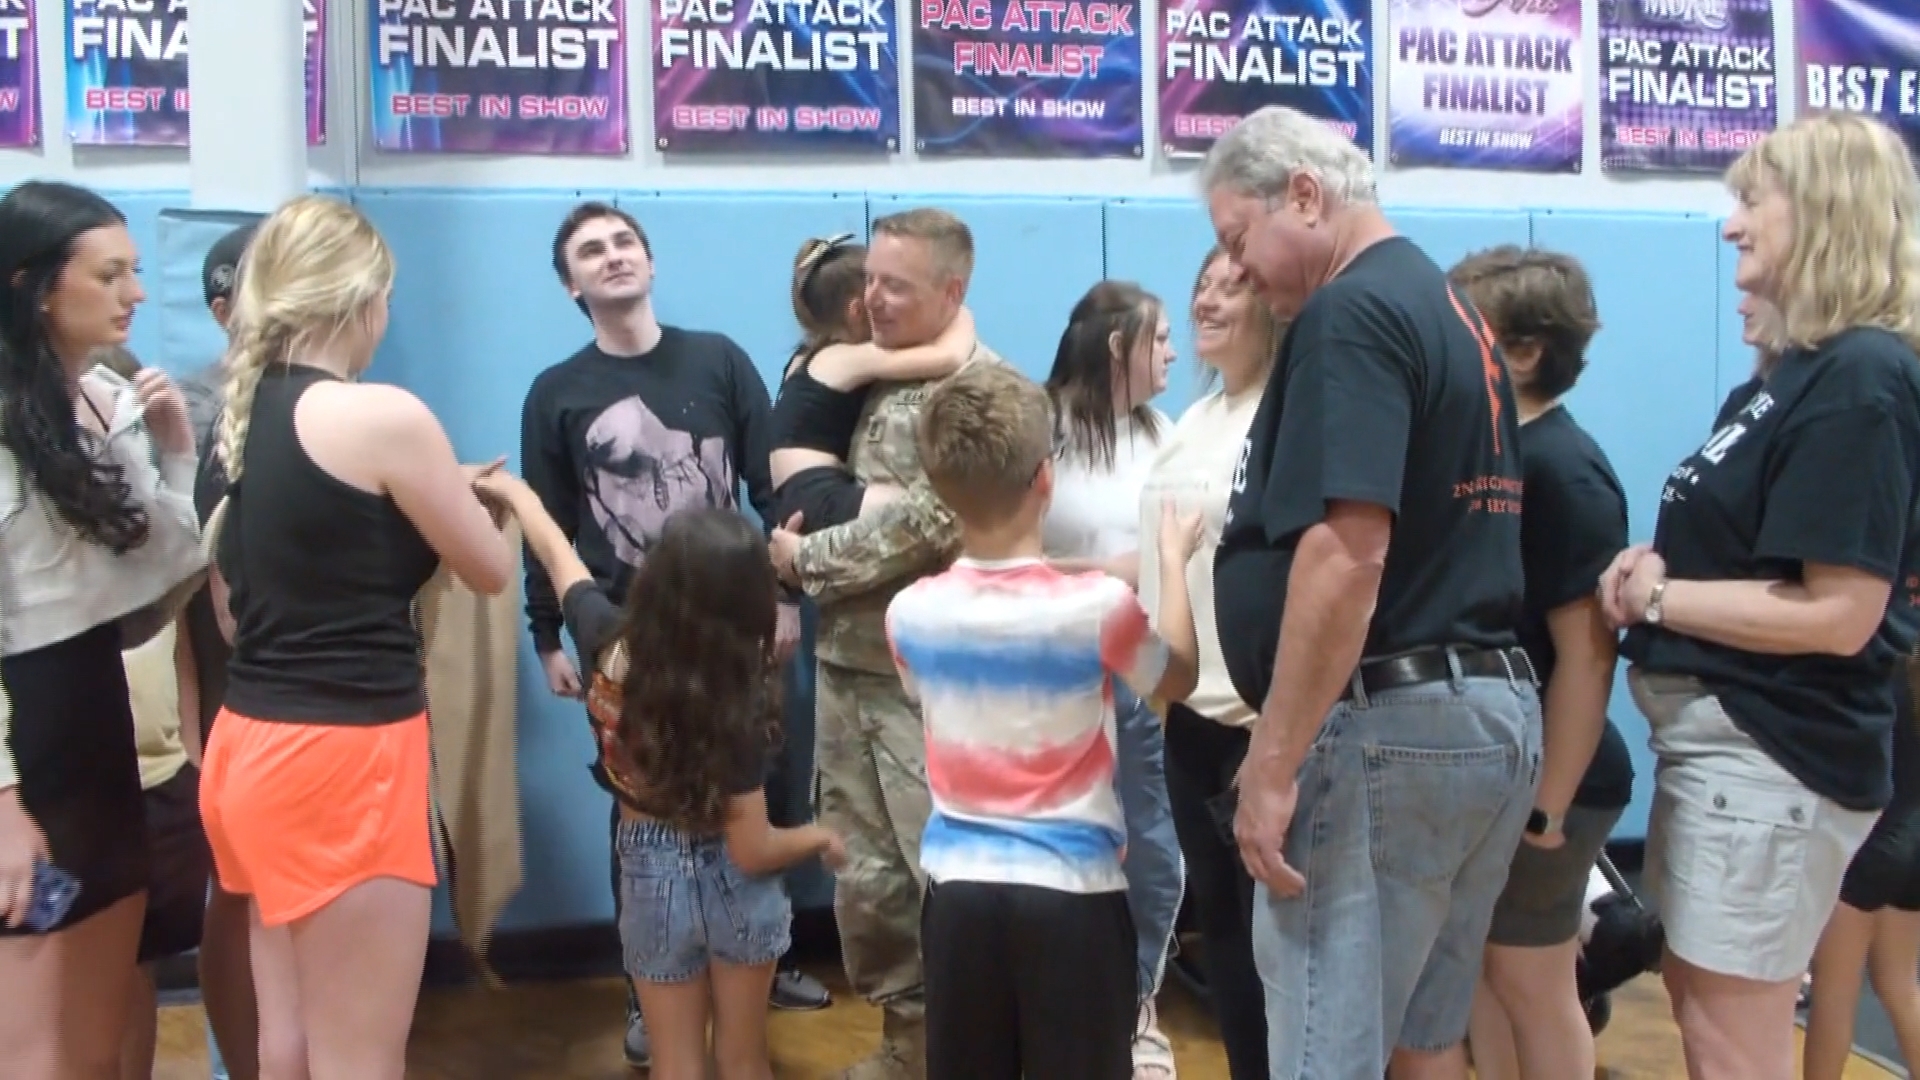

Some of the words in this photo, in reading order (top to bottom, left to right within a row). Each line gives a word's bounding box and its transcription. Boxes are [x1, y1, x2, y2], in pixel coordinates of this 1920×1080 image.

[660, 0, 734, 23] PAC
[747, 0, 887, 25] ATTACK
[921, 0, 992, 29] PAC
[1002, 0, 1134, 35] ATTACK
[1166, 8, 1230, 38] PAC
[1242, 14, 1364, 45] ATTACK
[72, 17, 188, 59] FINA
[379, 25, 619, 69] FINALIST
[661, 29, 888, 71] FINALIST
[1399, 26, 1457, 64] PAC
[1465, 31, 1572, 72] ATTACK
[1609, 37, 1661, 65] PAC
[1671, 42, 1771, 70] ATTACK
[954, 41, 1104, 79] FINALIST
[1166, 42, 1365, 87] FINALIST
[86, 87, 165, 111] BEST
[1423, 73, 1549, 116] FINALIST
[1608, 67, 1774, 109] FINALIST
[1806, 64, 1889, 112] BEST
[392, 94, 469, 116] BEST
[480, 95, 511, 119] IN
[519, 95, 608, 120] SHOW
[672, 105, 749, 129] BEST
[757, 106, 788, 131] IN
[795, 106, 881, 131] SHOW
[952, 97, 1008, 116] BEST
[1015, 98, 1036, 117] IN
[1043, 99, 1105, 118] SHOW
[1616, 126, 1670, 147] BEST
[1675, 128, 1699, 148] IN
